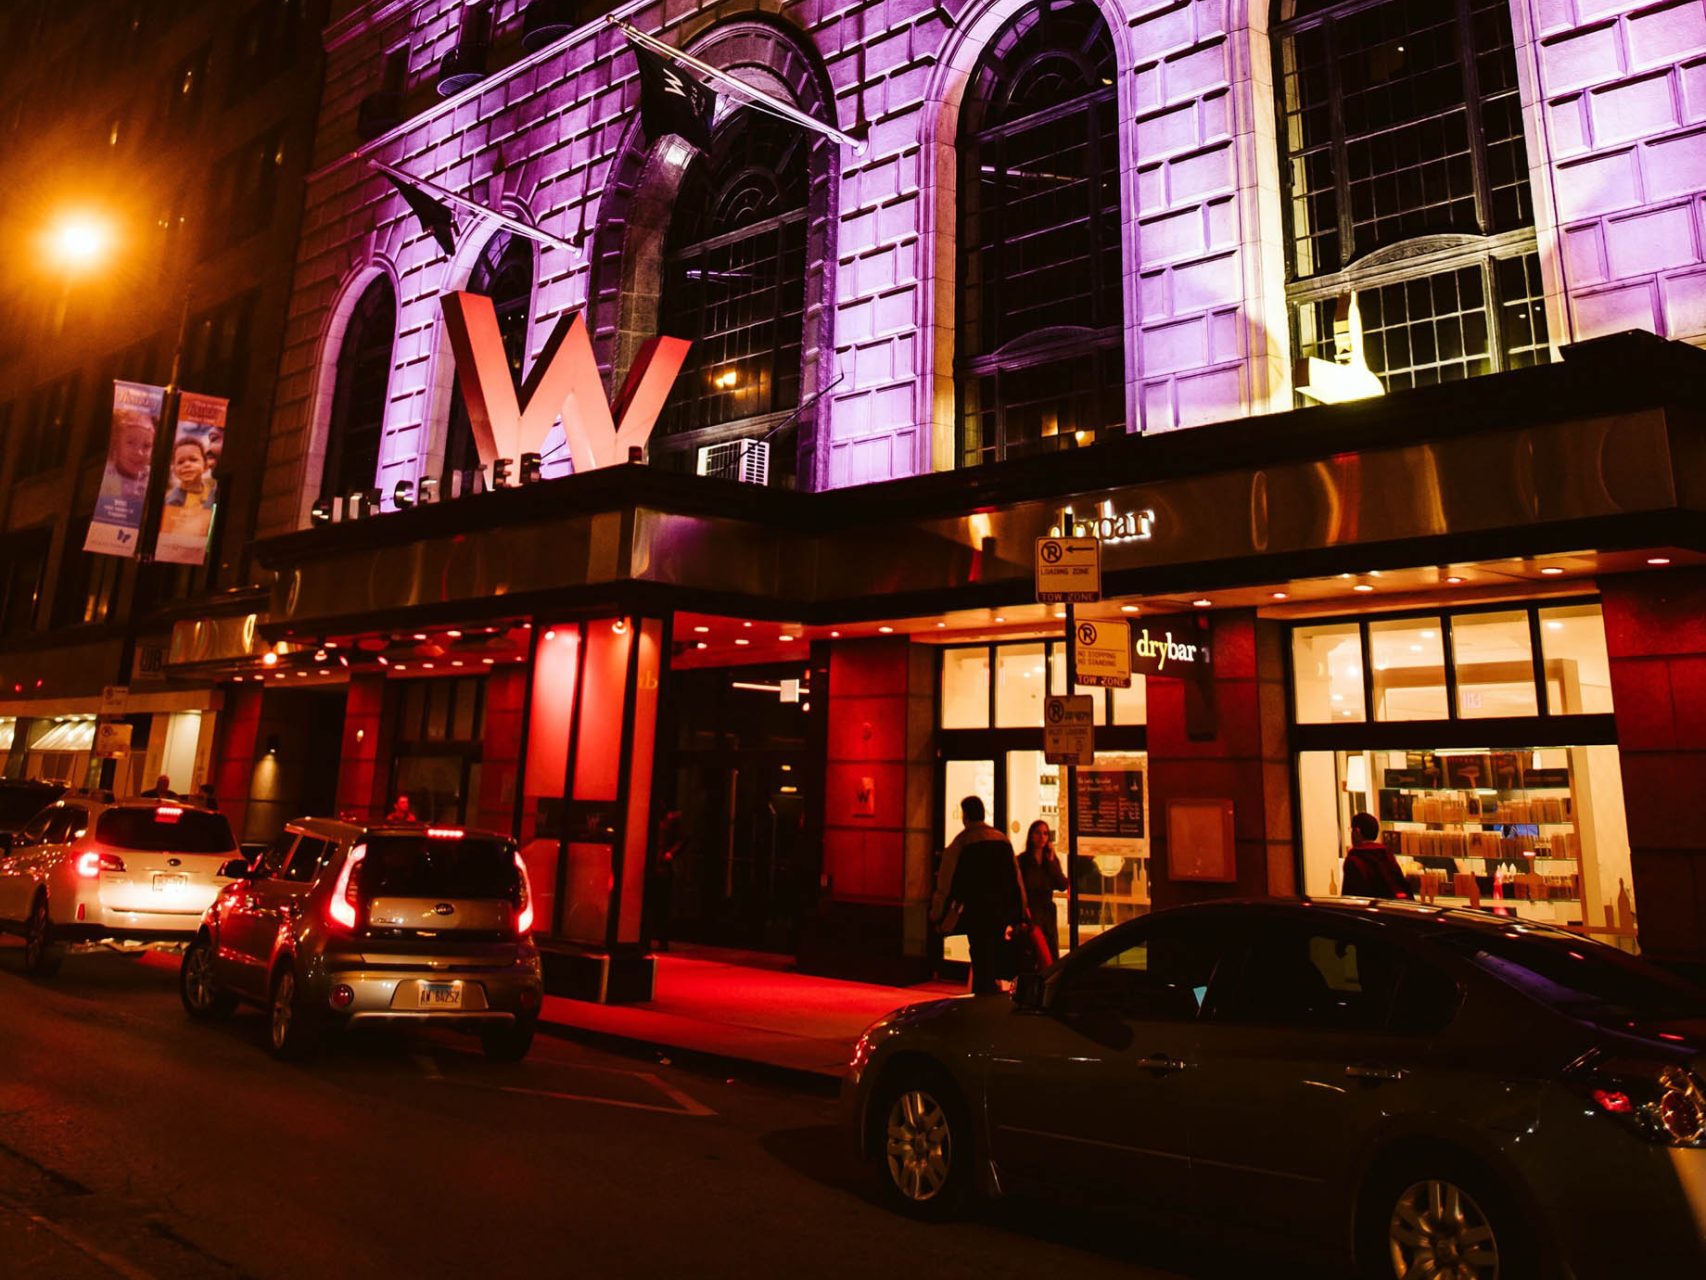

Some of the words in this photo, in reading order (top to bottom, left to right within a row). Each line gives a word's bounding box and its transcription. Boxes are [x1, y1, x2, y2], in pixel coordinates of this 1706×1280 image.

[440, 291, 693, 490] W
[1040, 567, 1069, 576] LOADING
[1072, 567, 1090, 575] ZONE
[1041, 593, 1063, 602] TOW
[1066, 593, 1095, 602] ZONE
[1136, 629, 1197, 671] drybar
[1078, 675, 1097, 685] TOW
[1101, 676, 1127, 687] ZONE
